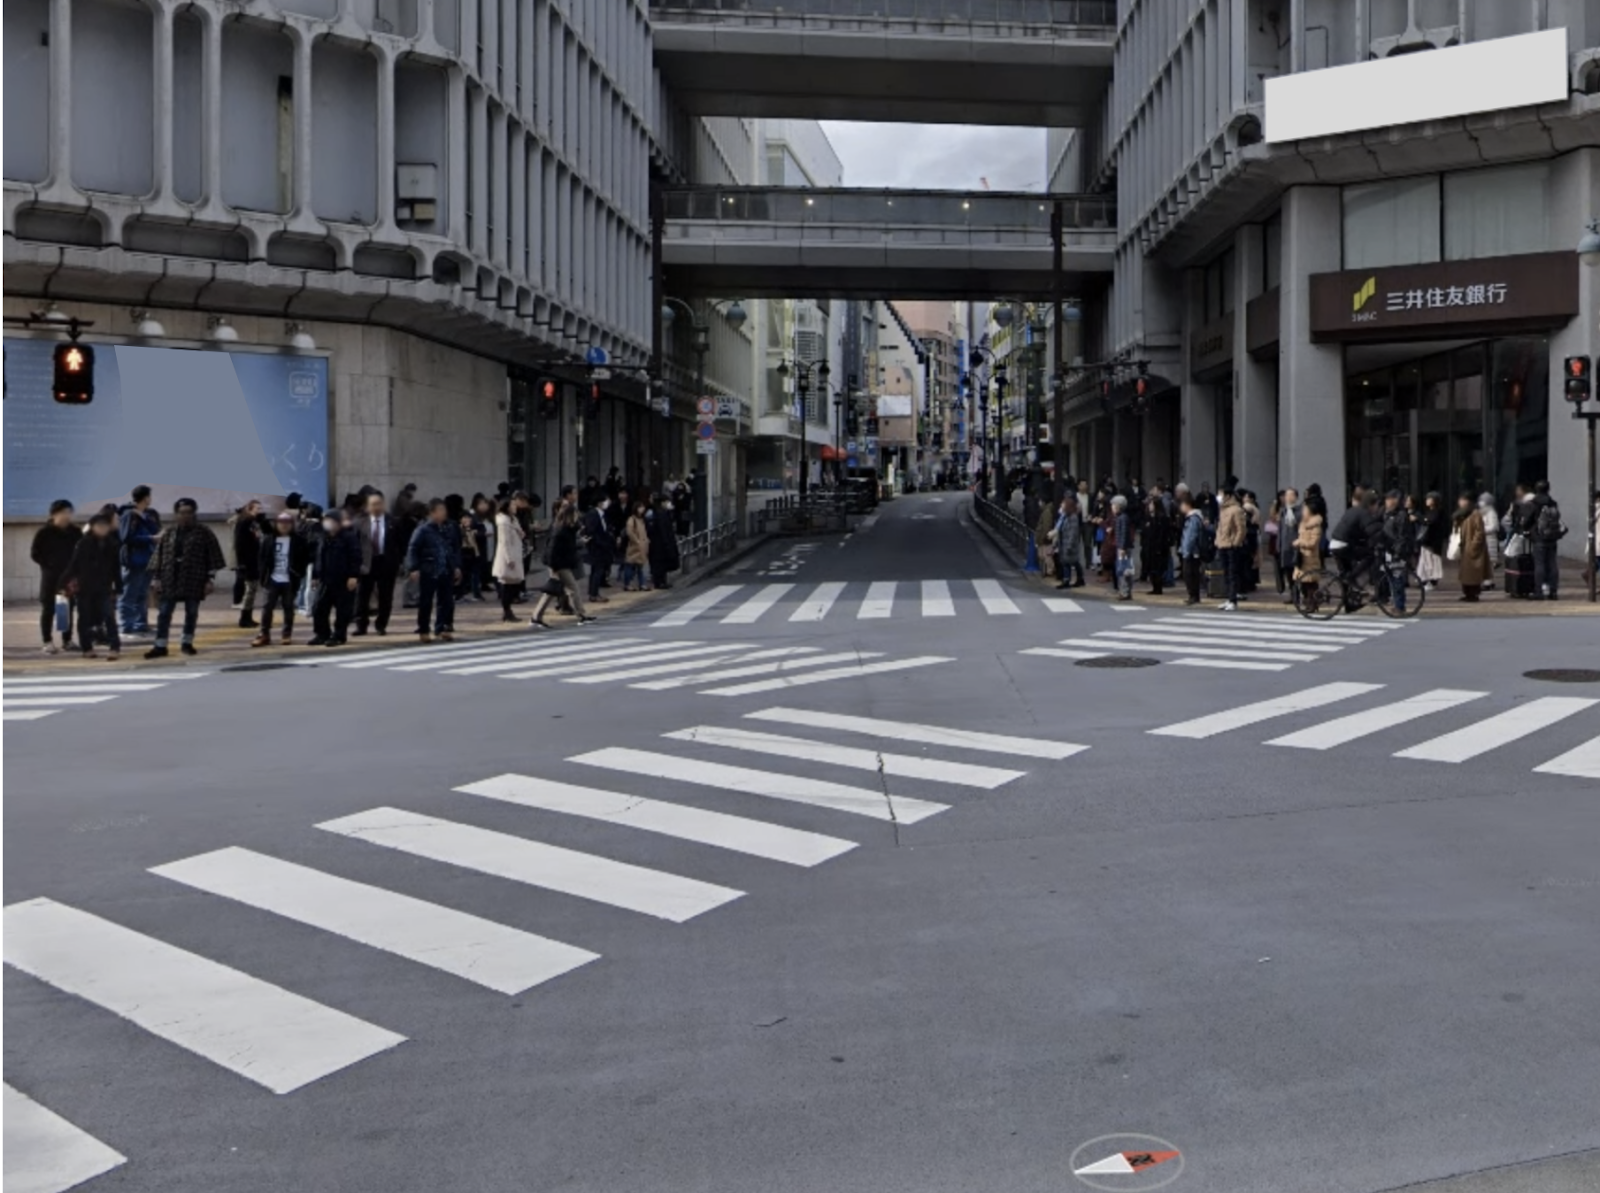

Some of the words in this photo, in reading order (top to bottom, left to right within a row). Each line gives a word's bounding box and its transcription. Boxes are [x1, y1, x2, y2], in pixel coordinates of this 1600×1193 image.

[1386, 283, 1506, 310] 三井住友銀行
